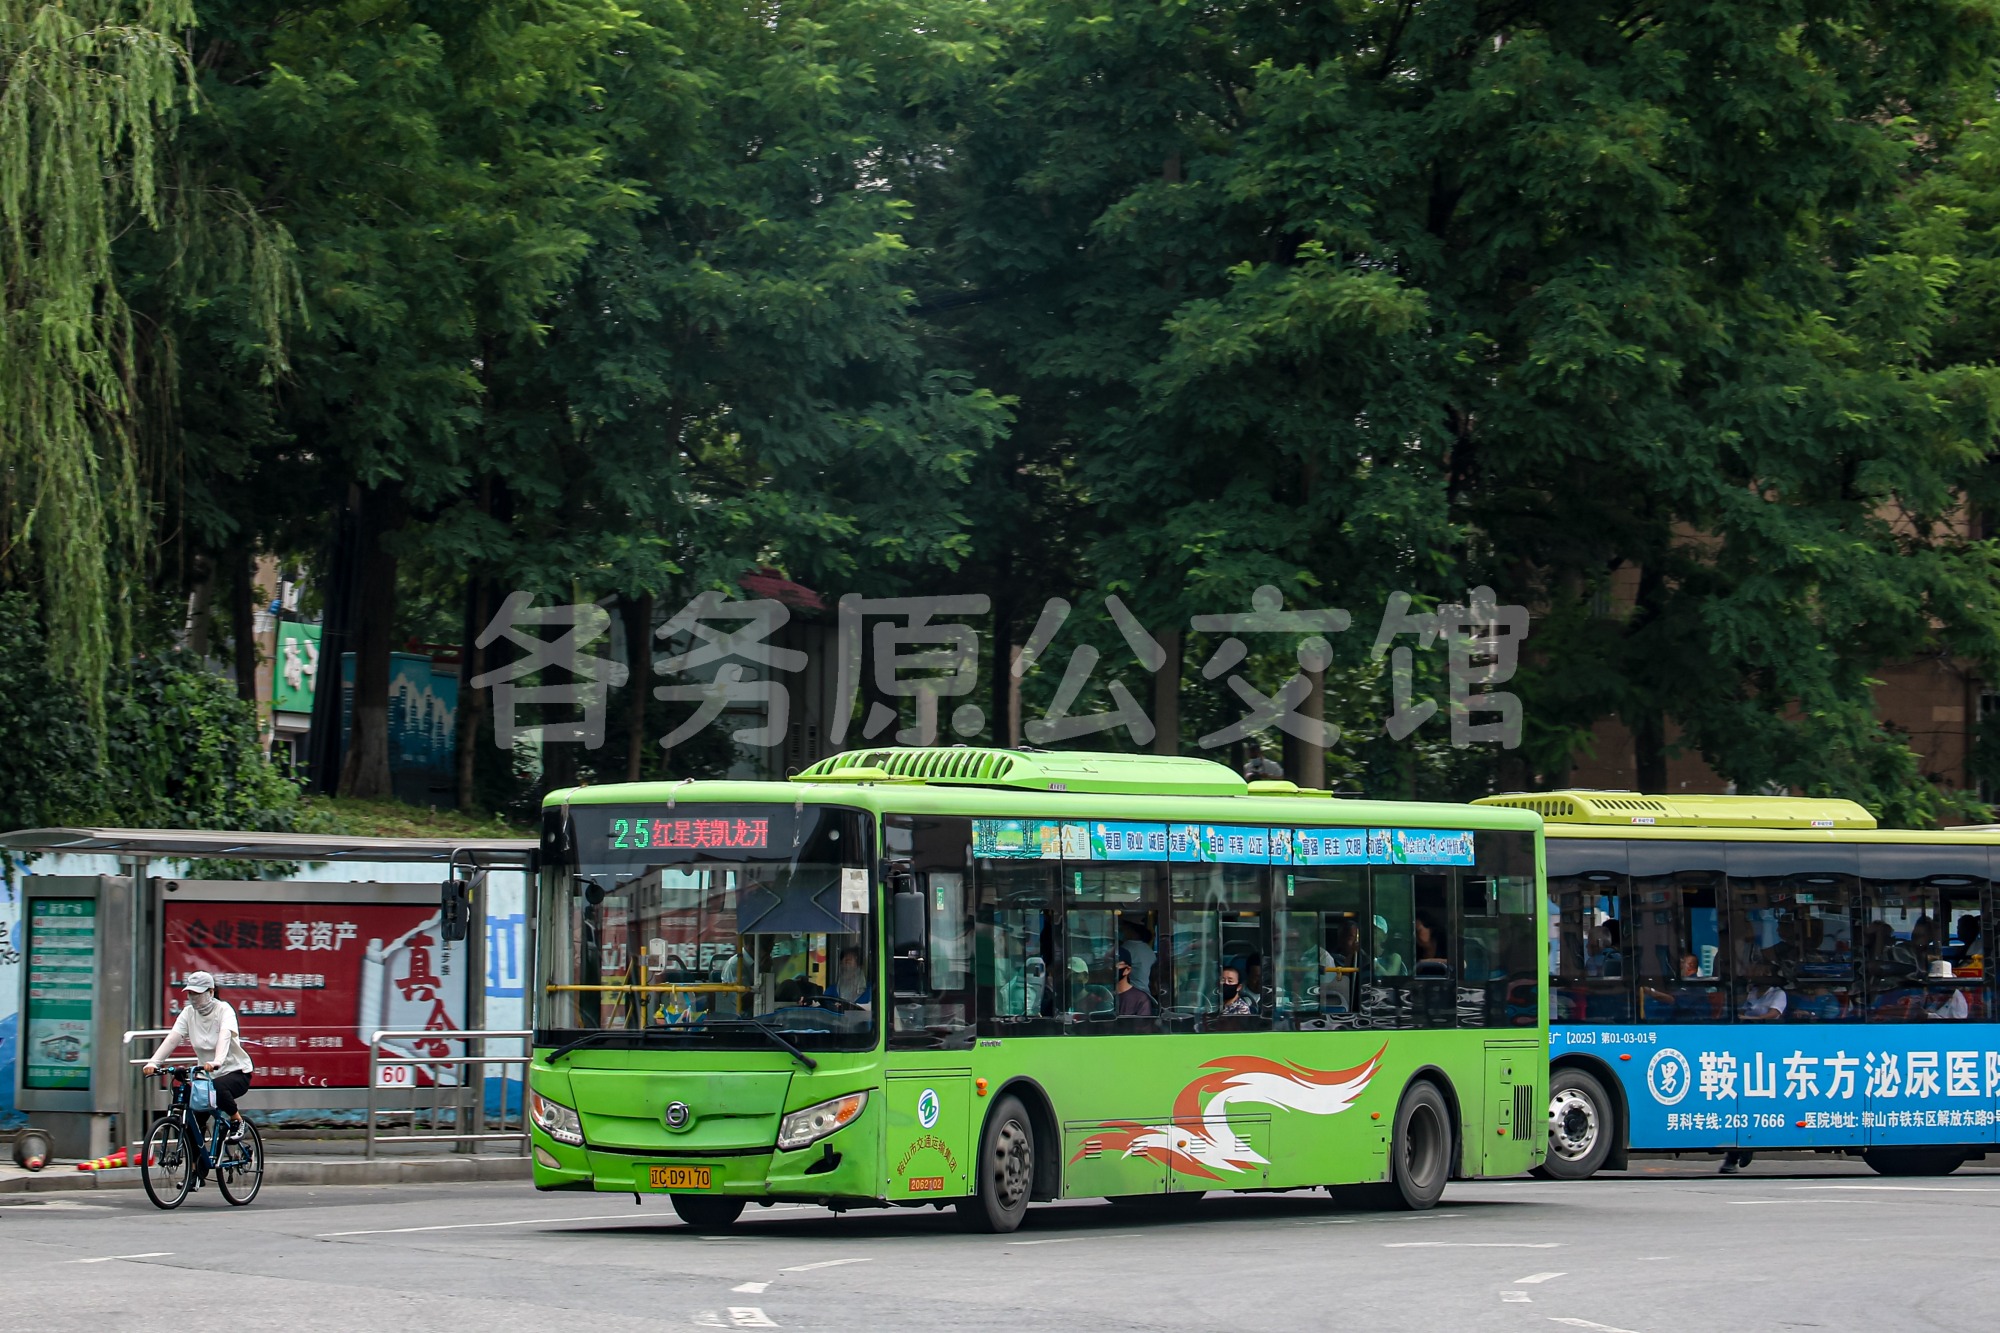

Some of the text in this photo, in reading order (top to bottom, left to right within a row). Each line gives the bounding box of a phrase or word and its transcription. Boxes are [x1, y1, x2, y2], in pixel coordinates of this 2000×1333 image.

[614, 818, 768, 847] 25 红星美凯龙开
[1105, 832, 1122, 850] 爱国
[1127, 832, 1143, 850] 敬业
[1148, 832, 1165, 850] 诚信
[1169, 833, 1186, 852] 友善
[1209, 835, 1224, 853] 自由
[1228, 835, 1244, 854] 平等
[1248, 836, 1263, 855] 公正
[1302, 838, 1319, 856] 富强
[1324, 838, 1340, 856] 民主
[1345, 838, 1362, 855] 文明
[186, 918, 358, 951] 企业数据变资产
[382, 1066, 406, 1083] 60
[1724, 1114, 1749, 1129] 263
[1753, 1113, 1785, 1128] 7666
[911, 1179, 942, 1190] 2062102
